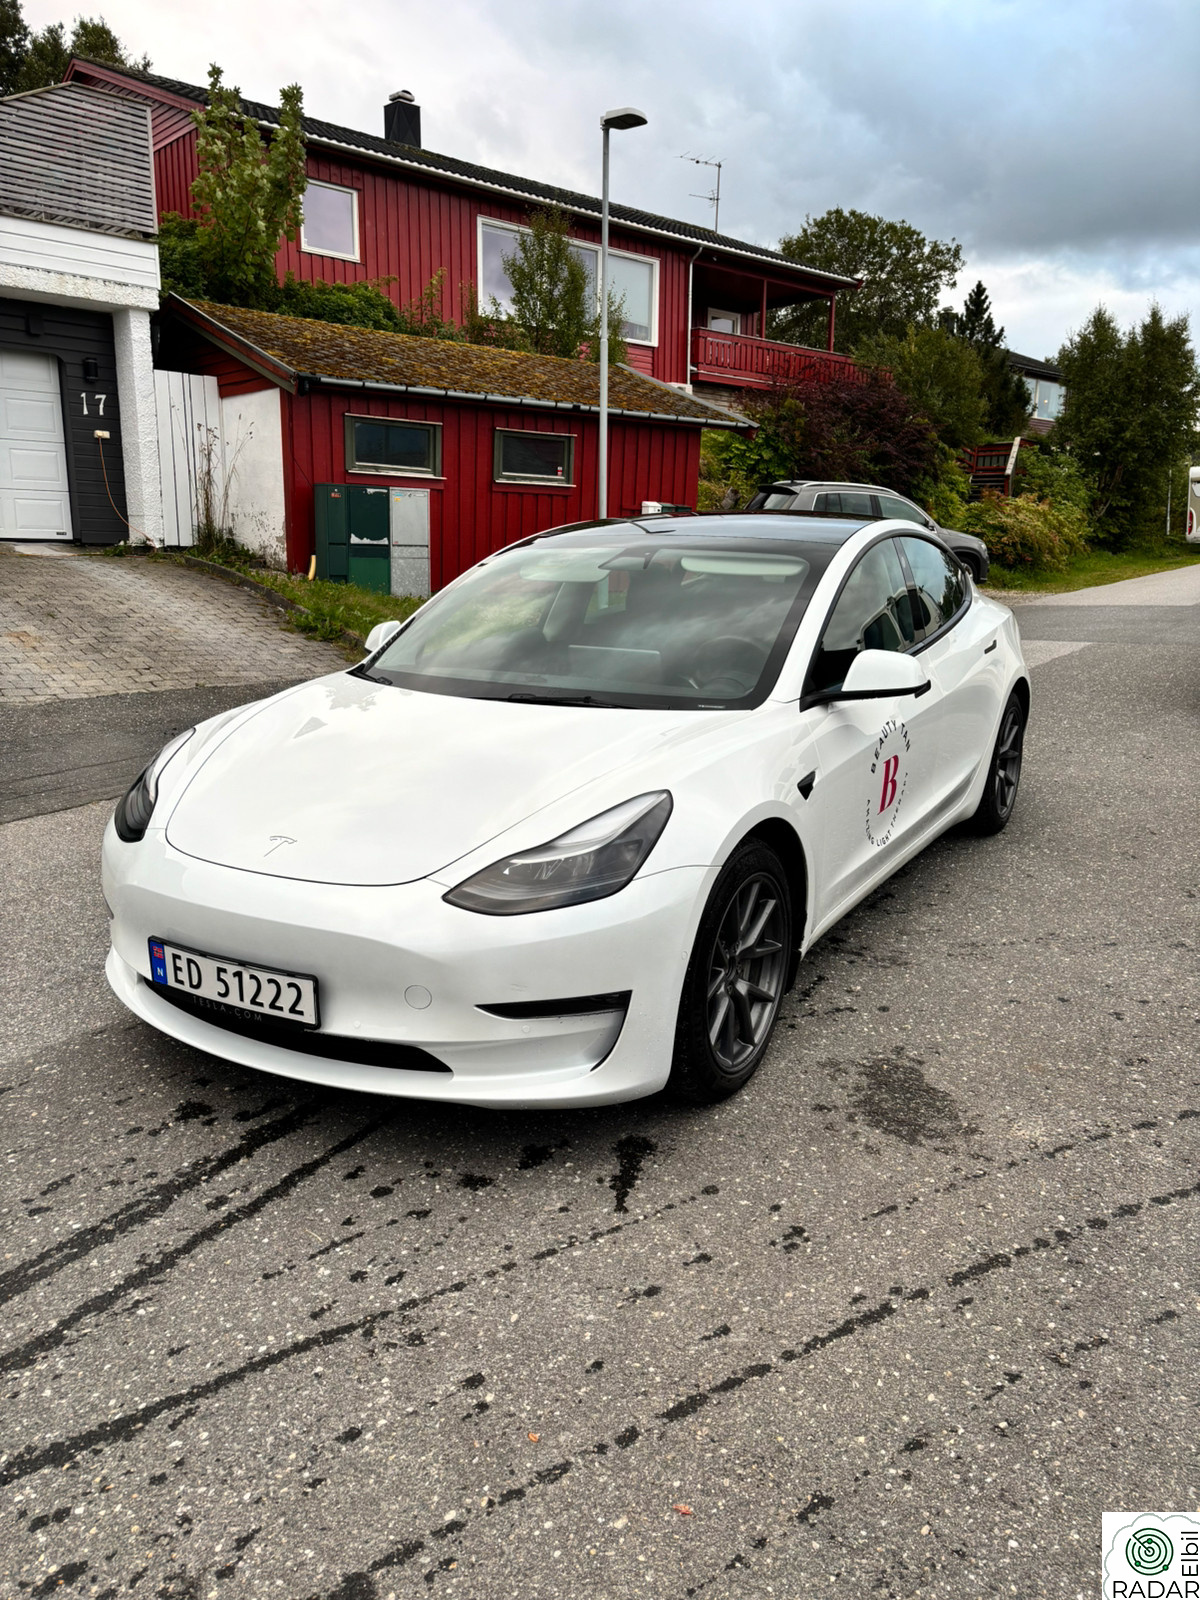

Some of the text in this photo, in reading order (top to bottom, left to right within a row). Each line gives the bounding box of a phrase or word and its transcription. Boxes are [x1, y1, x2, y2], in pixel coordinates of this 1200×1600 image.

[80, 392, 107, 416] 17
[871, 719, 910, 773] BEAUTY TAN
[877, 754, 899, 815] B
[876, 829, 892, 847] LIGHT
[157, 967, 164, 977] N
[171, 953, 305, 1016] ED 51222
[192, 995, 263, 1022] TESLA.COM
